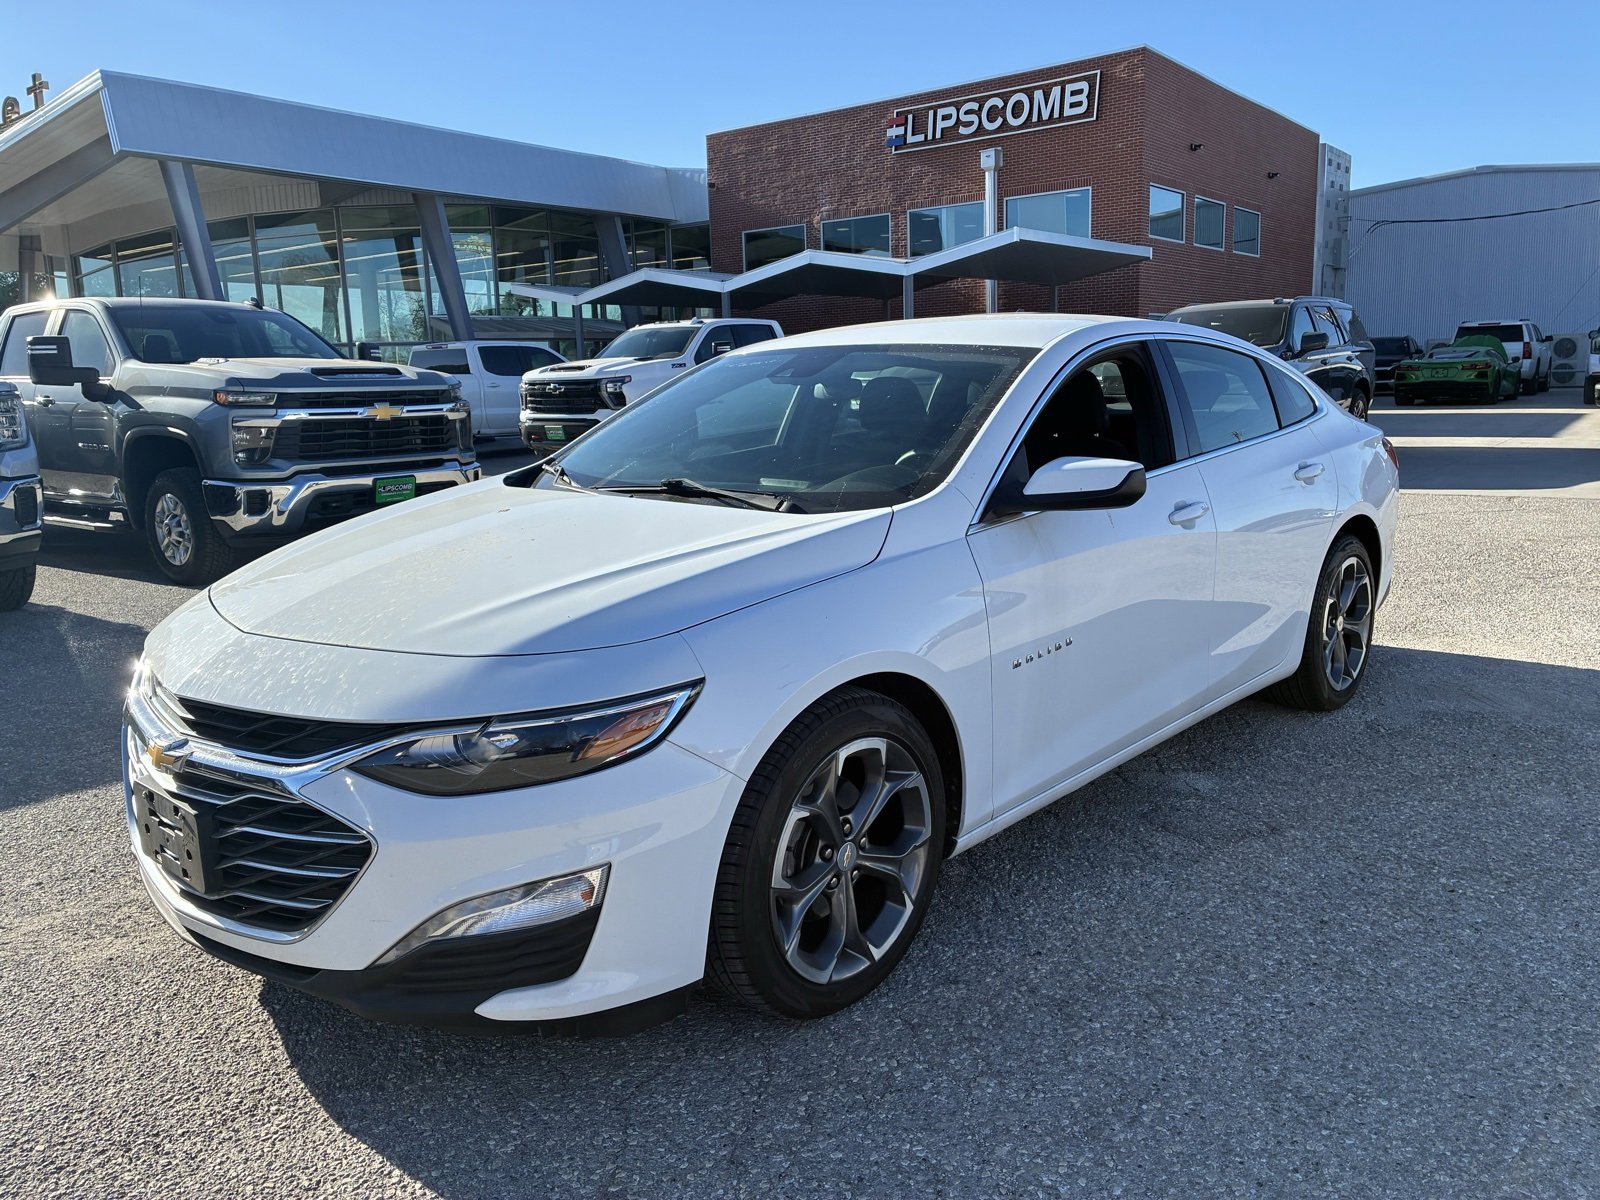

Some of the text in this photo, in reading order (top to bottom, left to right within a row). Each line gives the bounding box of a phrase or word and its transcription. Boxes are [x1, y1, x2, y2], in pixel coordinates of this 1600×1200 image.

[906, 81, 1090, 144] LIPSCOMB
[380, 483, 413, 491] LIPSCOMB
[1012, 637, 1073, 669] MALIBU
